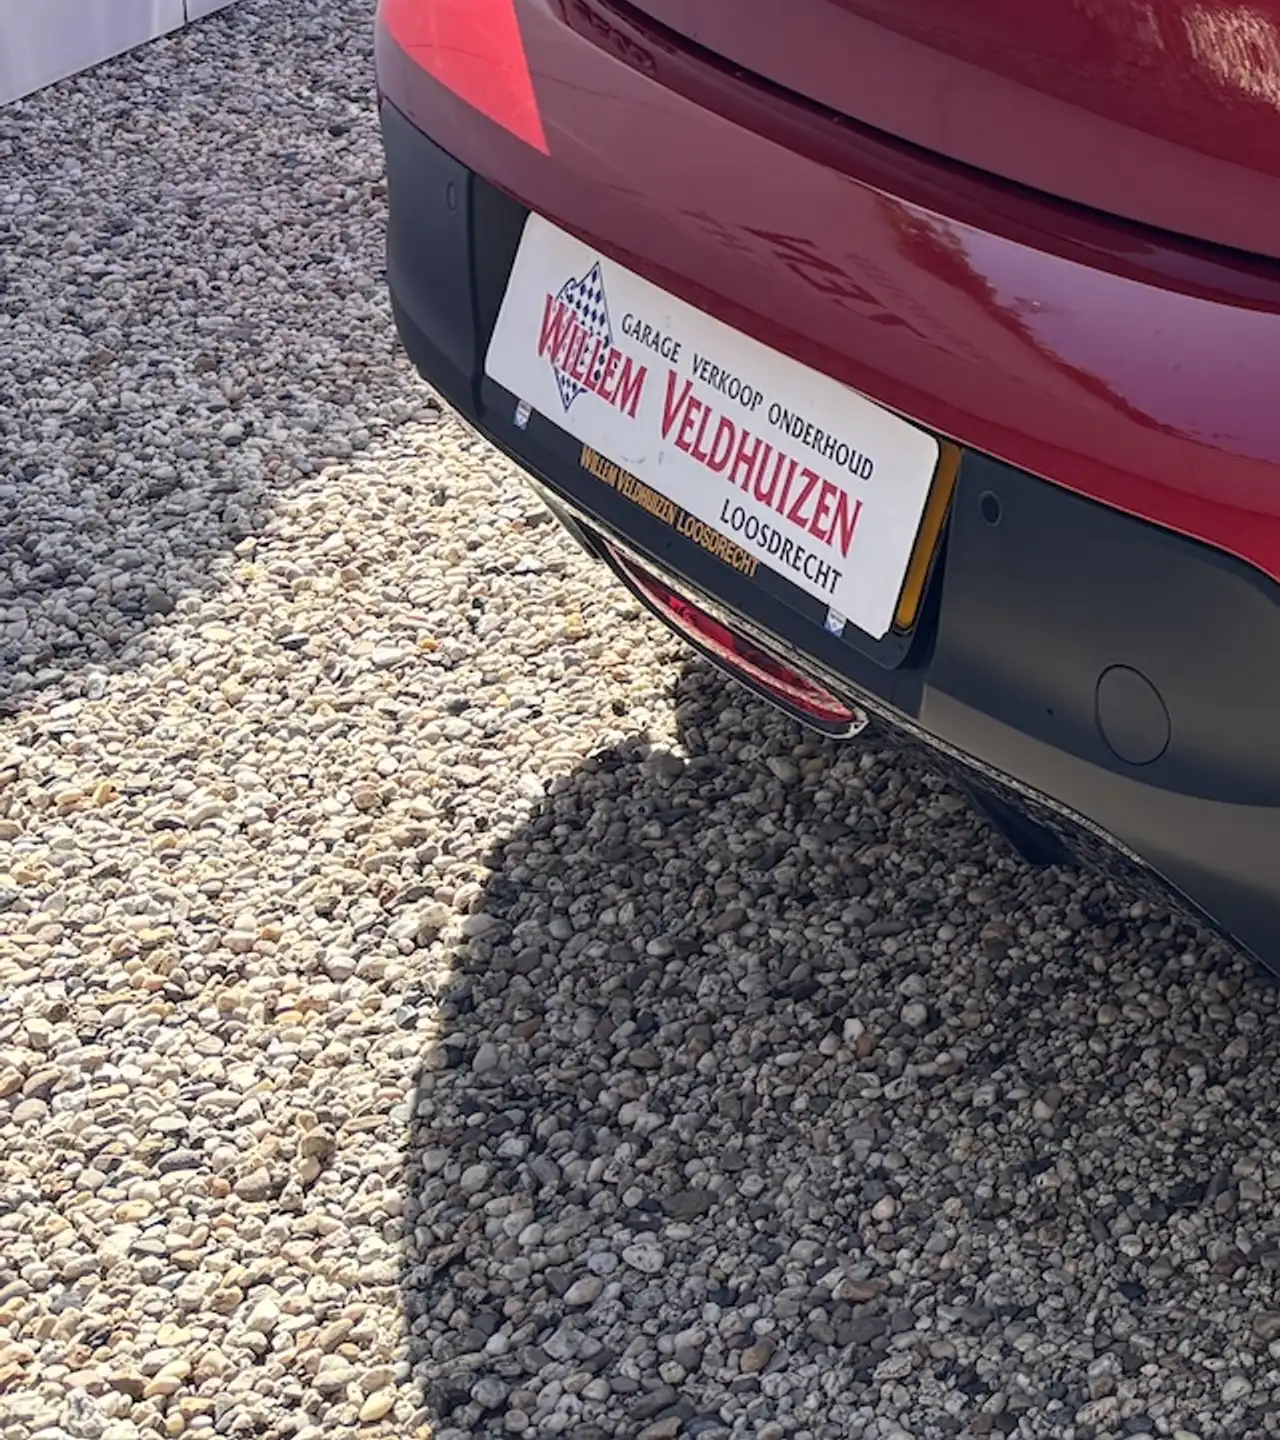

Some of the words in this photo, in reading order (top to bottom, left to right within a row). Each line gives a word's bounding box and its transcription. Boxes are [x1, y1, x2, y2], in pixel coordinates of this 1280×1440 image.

[537, 292, 648, 419] WILLEM
[661, 368, 863, 559] VELDHUIZEN
[621, 313, 682, 364] GARAGE
[692, 352, 763, 413] VERKOOP
[768, 402, 874, 481] ONDERHOUD
[579, 443, 617, 490] WILLEM
[616, 462, 677, 526] VELDHUIZEN
[676, 509, 759, 578] LOOSDRECHT
[719, 498, 843, 596] LOOSDRECHT
